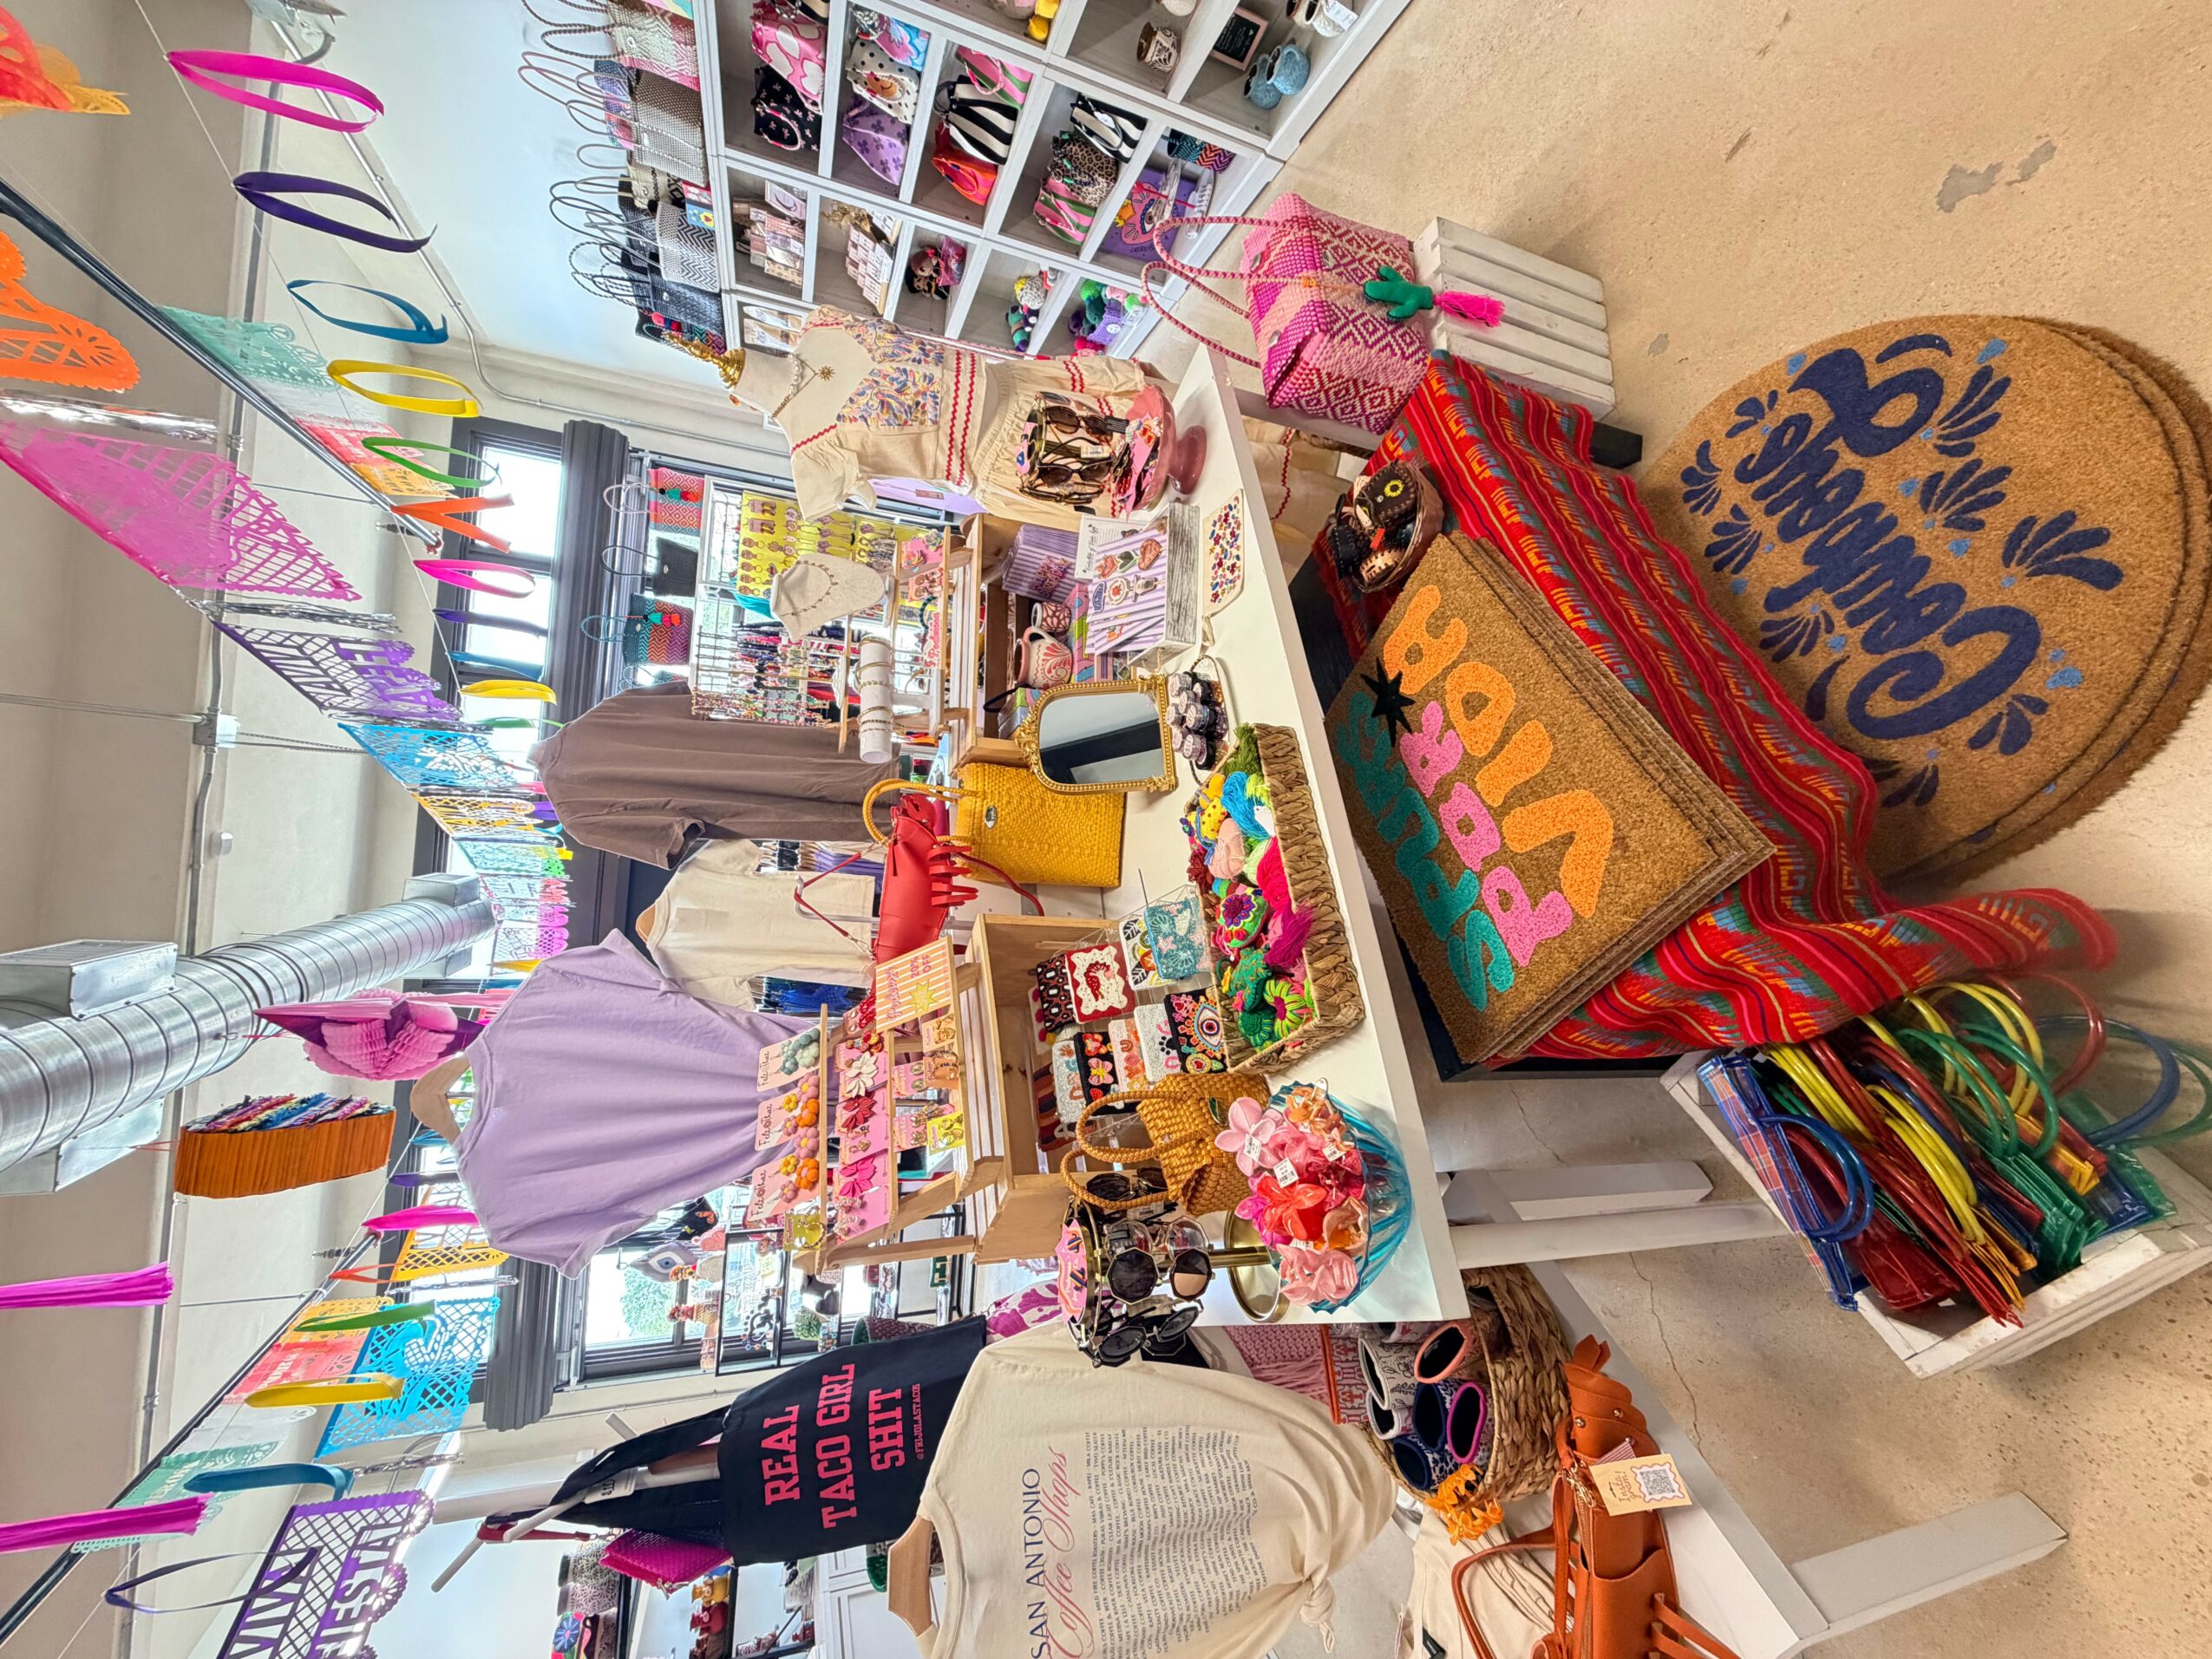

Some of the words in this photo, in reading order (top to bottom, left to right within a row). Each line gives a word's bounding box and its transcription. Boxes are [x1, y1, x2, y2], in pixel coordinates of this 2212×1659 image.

[1733, 346, 2043, 741] Cowboys
[1382, 585, 1614, 918] VIDA
[1335, 692, 1515, 1012] SPURS
[1398, 701, 1573, 966] POR
[910, 957, 919, 978] 20%
[762, 1103, 772, 1122] Thai
[756, 1169, 767, 1191] Thai
[815, 1363, 855, 1427] GIRL
[868, 1388, 905, 1471] SHIT
[762, 1405, 800, 1506] REAL
[815, 1434, 857, 1528] TACO
[1040, 1446, 1081, 1551] Shops
[1612, 1474, 1631, 1503] Insta
[1614, 1471, 1641, 1499] gram!
[1023, 1468, 1044, 1587] ANTONIO
[1028, 1601, 1049, 1659] SAN
[1042, 1563, 1094, 1659] Coffee
